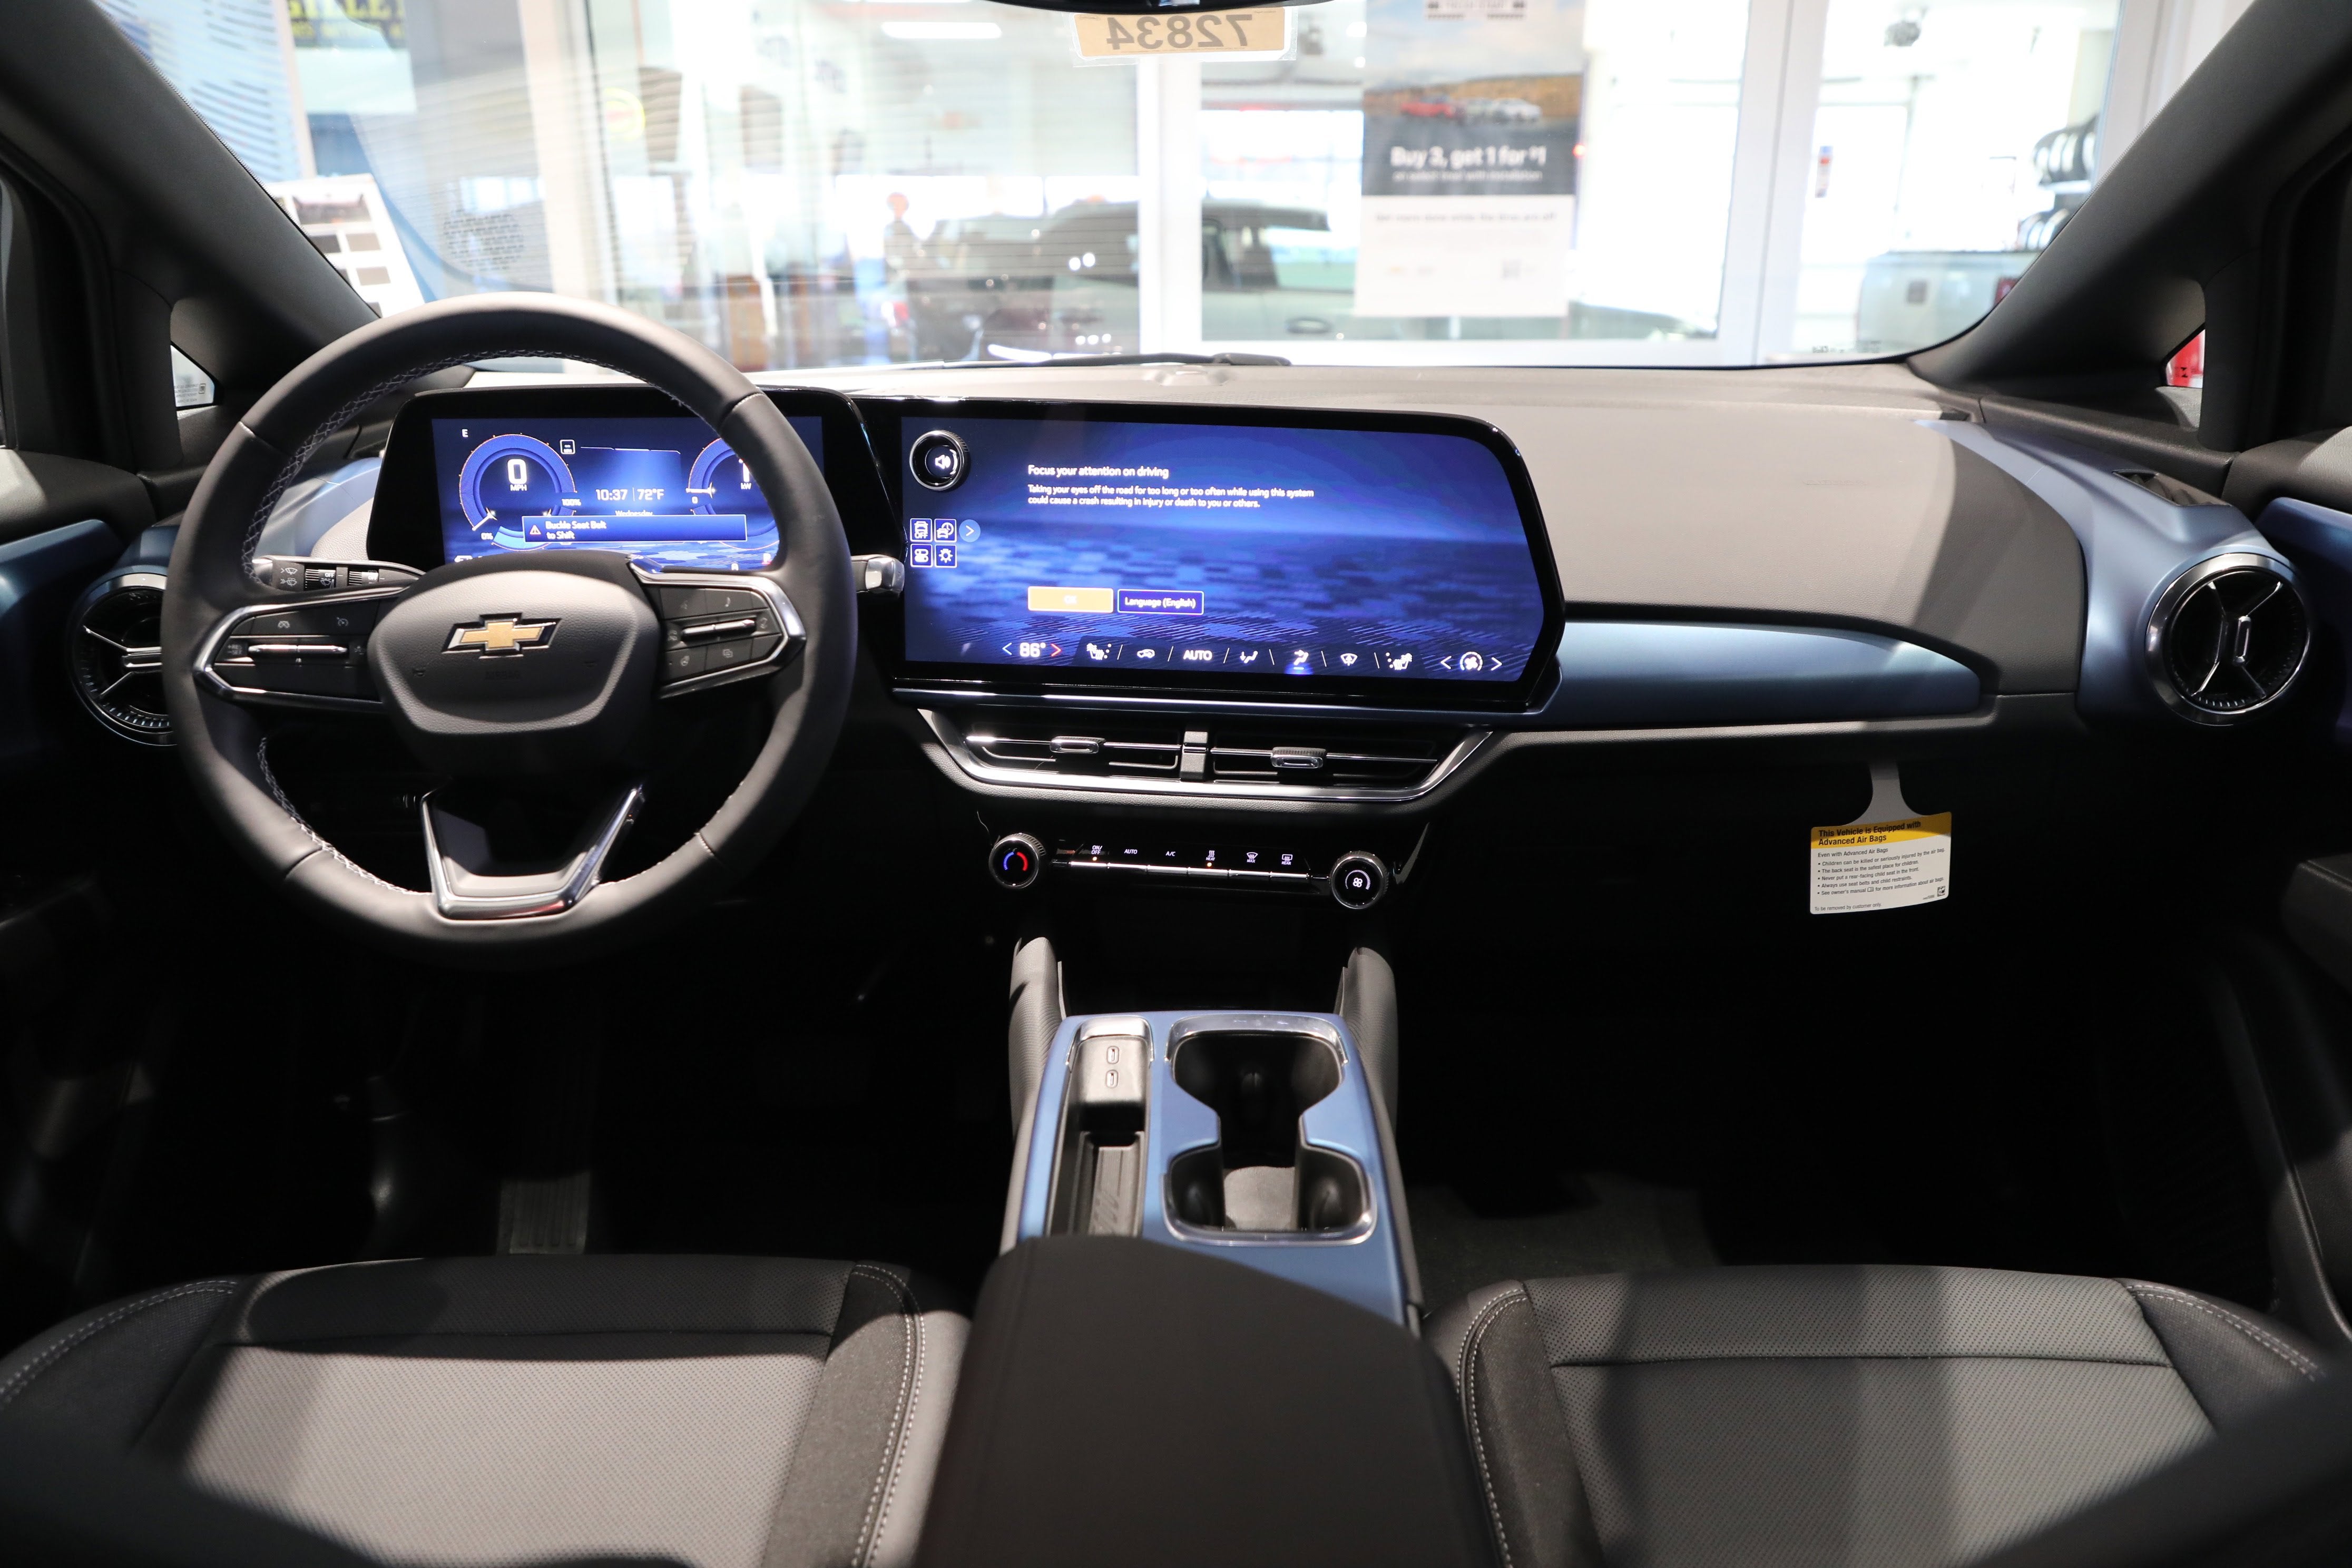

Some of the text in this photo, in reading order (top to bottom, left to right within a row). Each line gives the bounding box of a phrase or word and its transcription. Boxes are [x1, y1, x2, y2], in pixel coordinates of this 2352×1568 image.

[1390, 146, 1427, 169] Buy
[1450, 146, 1483, 170] get
[1485, 145, 1496, 166] 1
[1498, 145, 1527, 166] for
[462, 429, 468, 437] E
[507, 459, 527, 484] 0
[1028, 465, 1169, 479] Focus your attention on driving
[595, 488, 664, 501] 10:37 72°F
[1027, 484, 1052, 495] Taking
[1053, 486, 1070, 495] your
[1071, 486, 1088, 495] eyes
[1089, 485, 1102, 494] off
[1102, 485, 1114, 494] the
[1116, 485, 1133, 494] road
[1134, 485, 1146, 494] for
[1147, 486, 1160, 495] too
[1162, 486, 1179, 497] long
[1190, 487, 1204, 496] too
[1205, 487, 1226, 496] often
[1227, 487, 1247, 496] while
[1248, 488, 1270, 498] using
[1270, 487, 1285, 497] this
[1287, 489, 1314, 499] system
[1028, 495, 1048, 504] could
[1079, 496, 1099, 505] crash
[1101, 496, 1133, 507] resulting
[1142, 497, 1164, 507] injury
[1174, 497, 1197, 506] death
[1207, 499, 1221, 508] you
[1233, 498, 1260, 507] others.
[545, 521, 606, 530] Buckle Seat Belt
[556, 531, 575, 540] Shift
[763, 553, 771, 563] P
[1063, 595, 1077, 604] OK
[1124, 597, 1197, 609] Language (English)
[1019, 642, 1046, 658] 86°
[1183, 650, 1212, 661] AUTO
[1837, 828, 1863, 836] Vehicle
[1873, 823, 1905, 834] Equipped
[1819, 837, 1855, 846] Advanced
